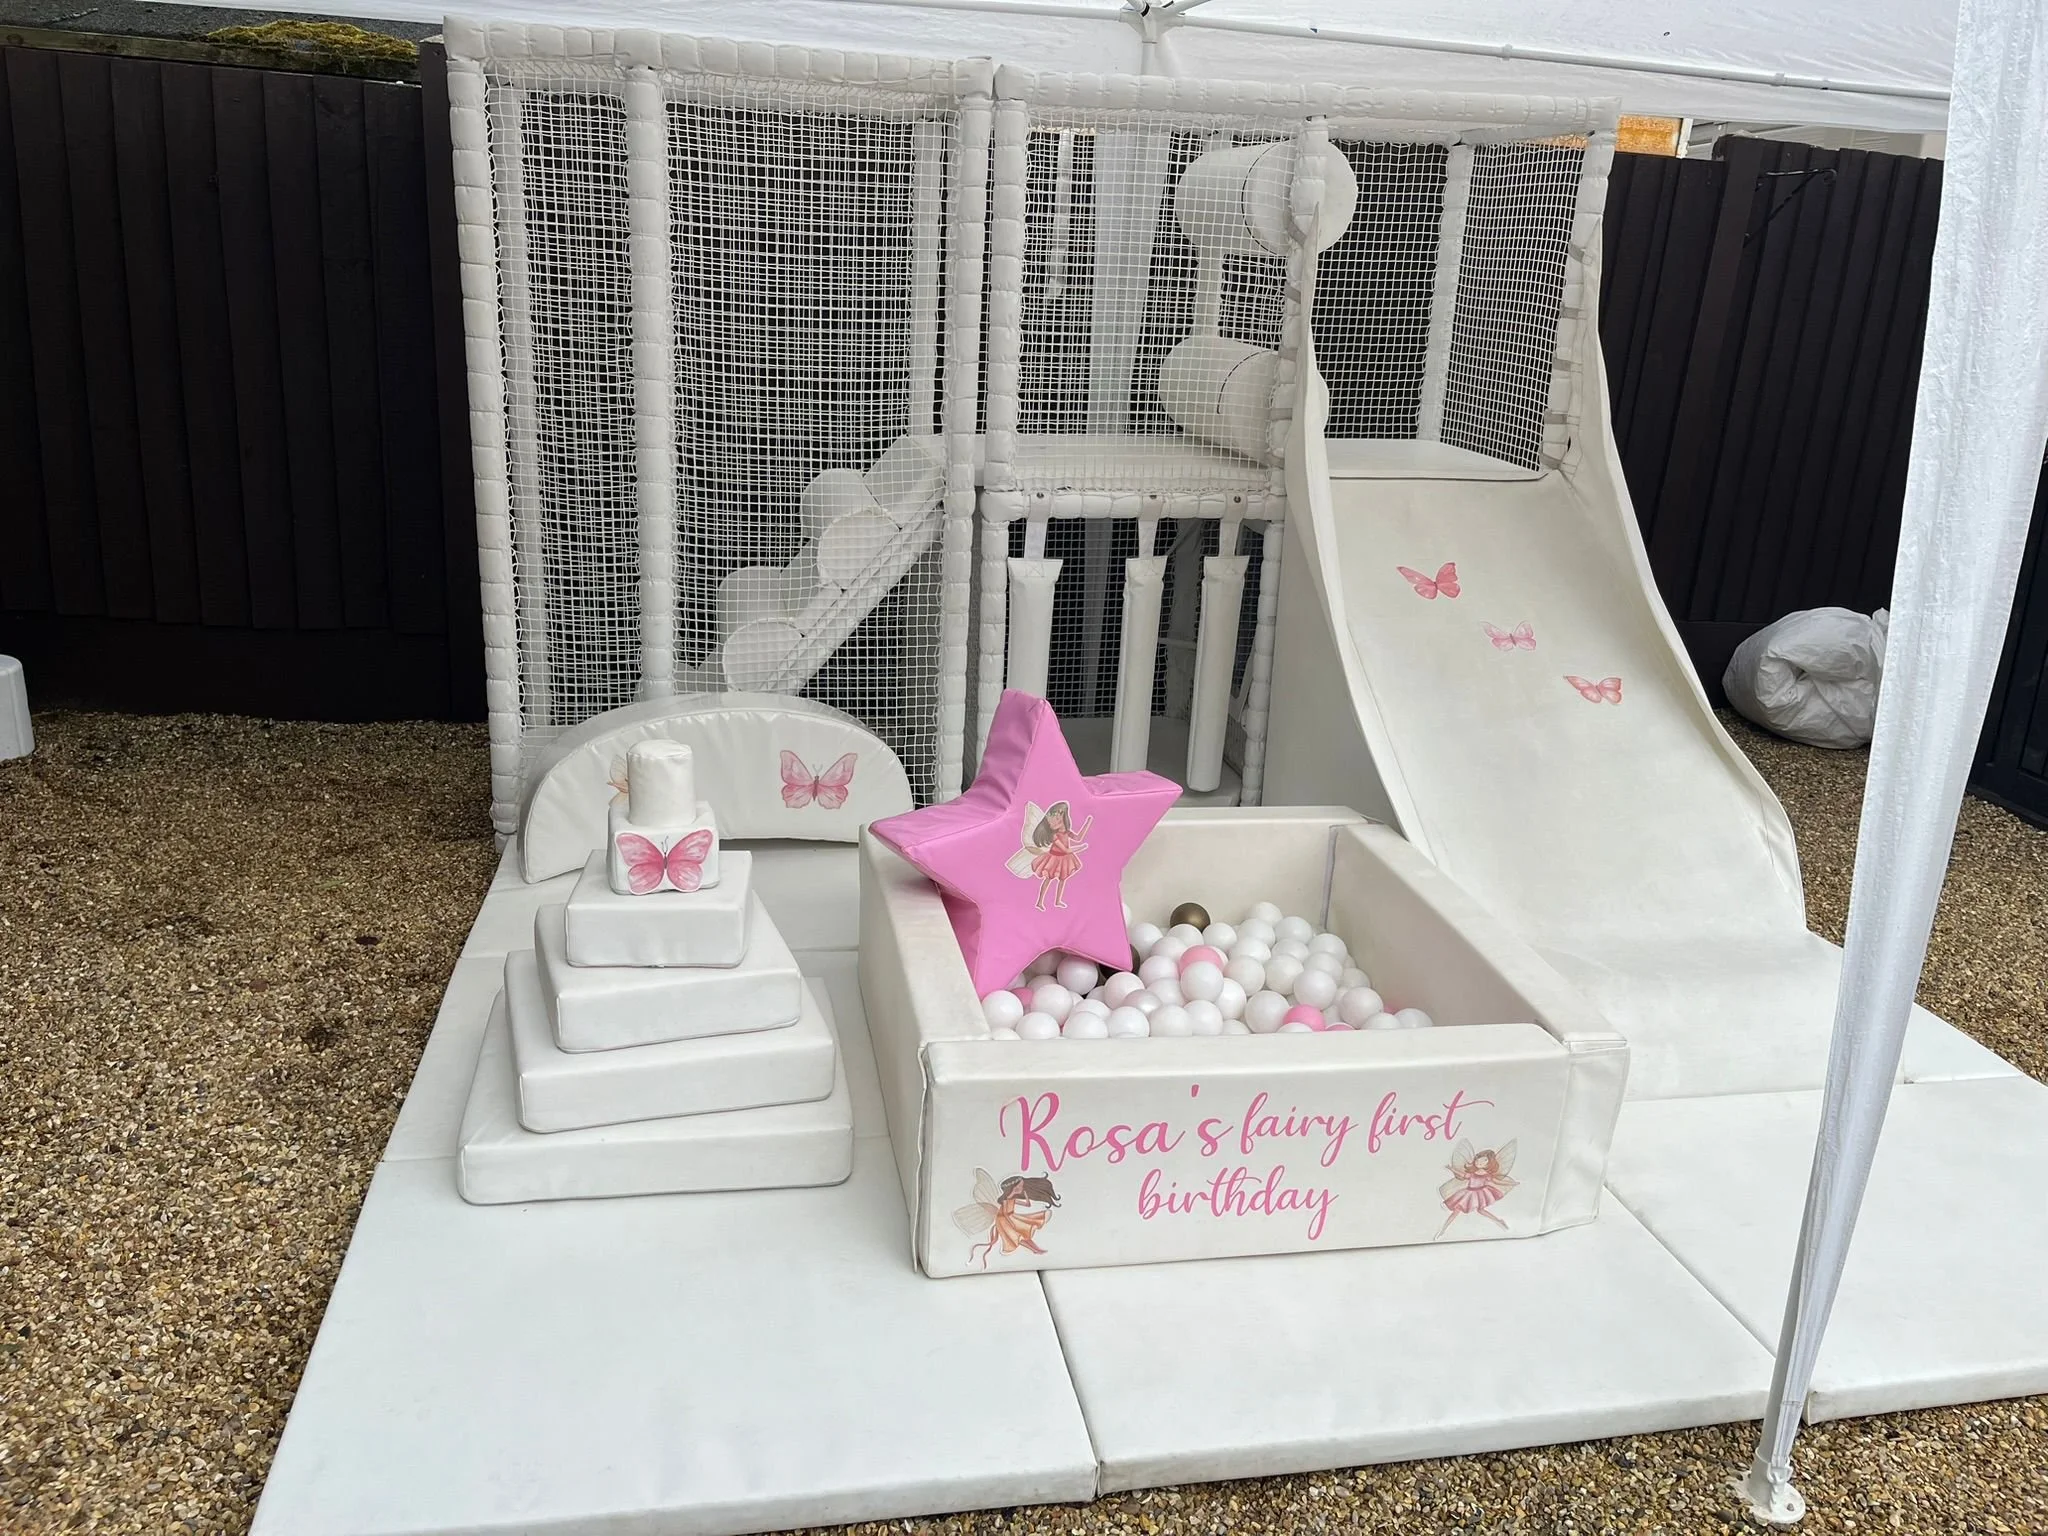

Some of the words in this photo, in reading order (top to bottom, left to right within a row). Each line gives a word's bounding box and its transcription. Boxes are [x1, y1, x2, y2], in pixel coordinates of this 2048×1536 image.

[1000, 1084, 1234, 1172] Rosa's
[1239, 1092, 1359, 1168] fairy
[1367, 1090, 1496, 1155] first
[1138, 1165, 1338, 1240] birthday
